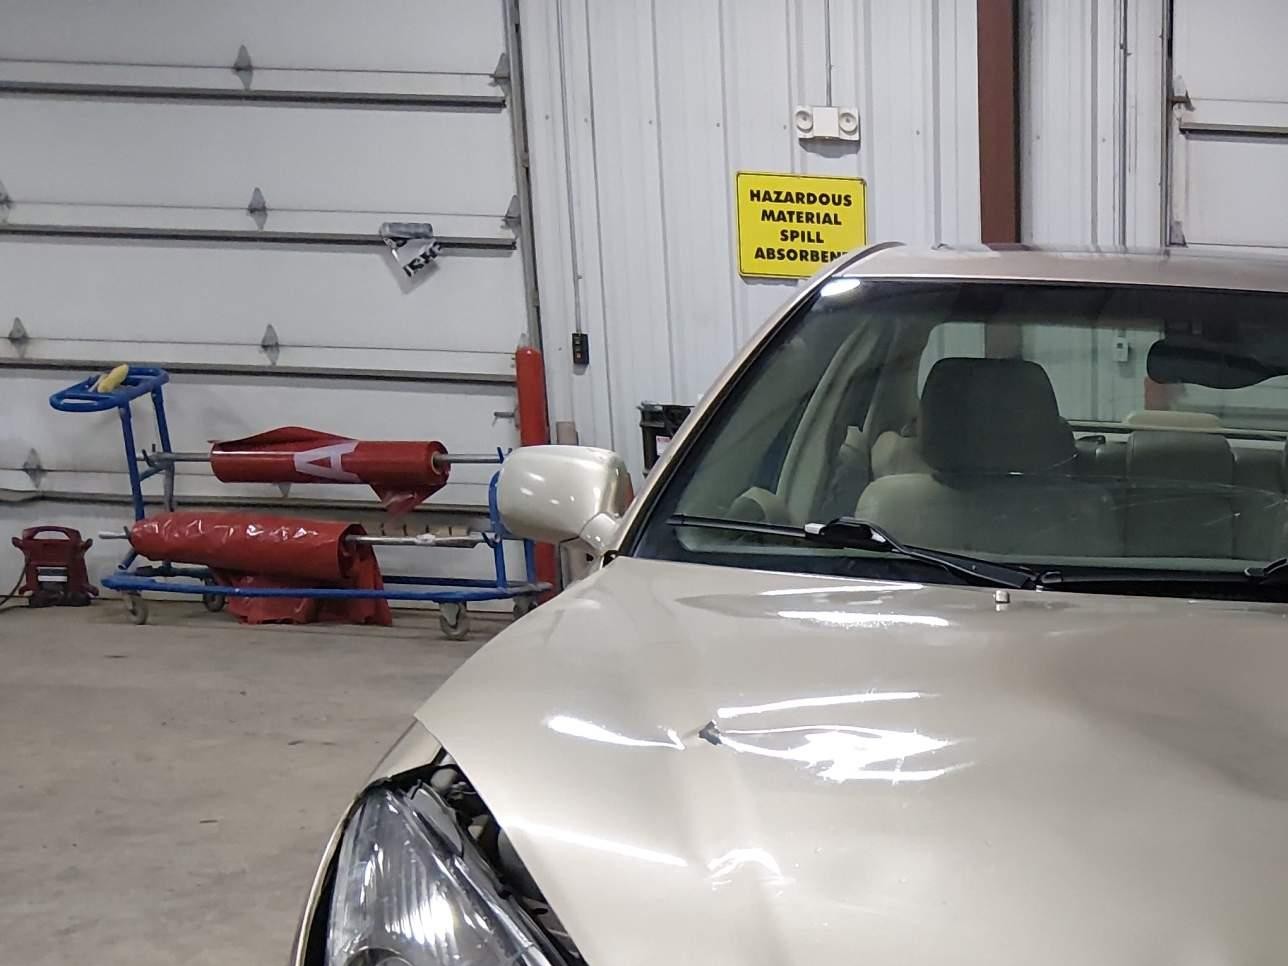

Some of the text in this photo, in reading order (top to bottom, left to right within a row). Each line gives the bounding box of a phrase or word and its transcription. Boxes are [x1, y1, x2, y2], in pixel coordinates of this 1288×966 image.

[749, 189, 852, 207] HAZARDOUS
[761, 210, 842, 226] MATERIAL
[780, 230, 825, 244] SPILL
[754, 247, 848, 263] ABSORBEN
